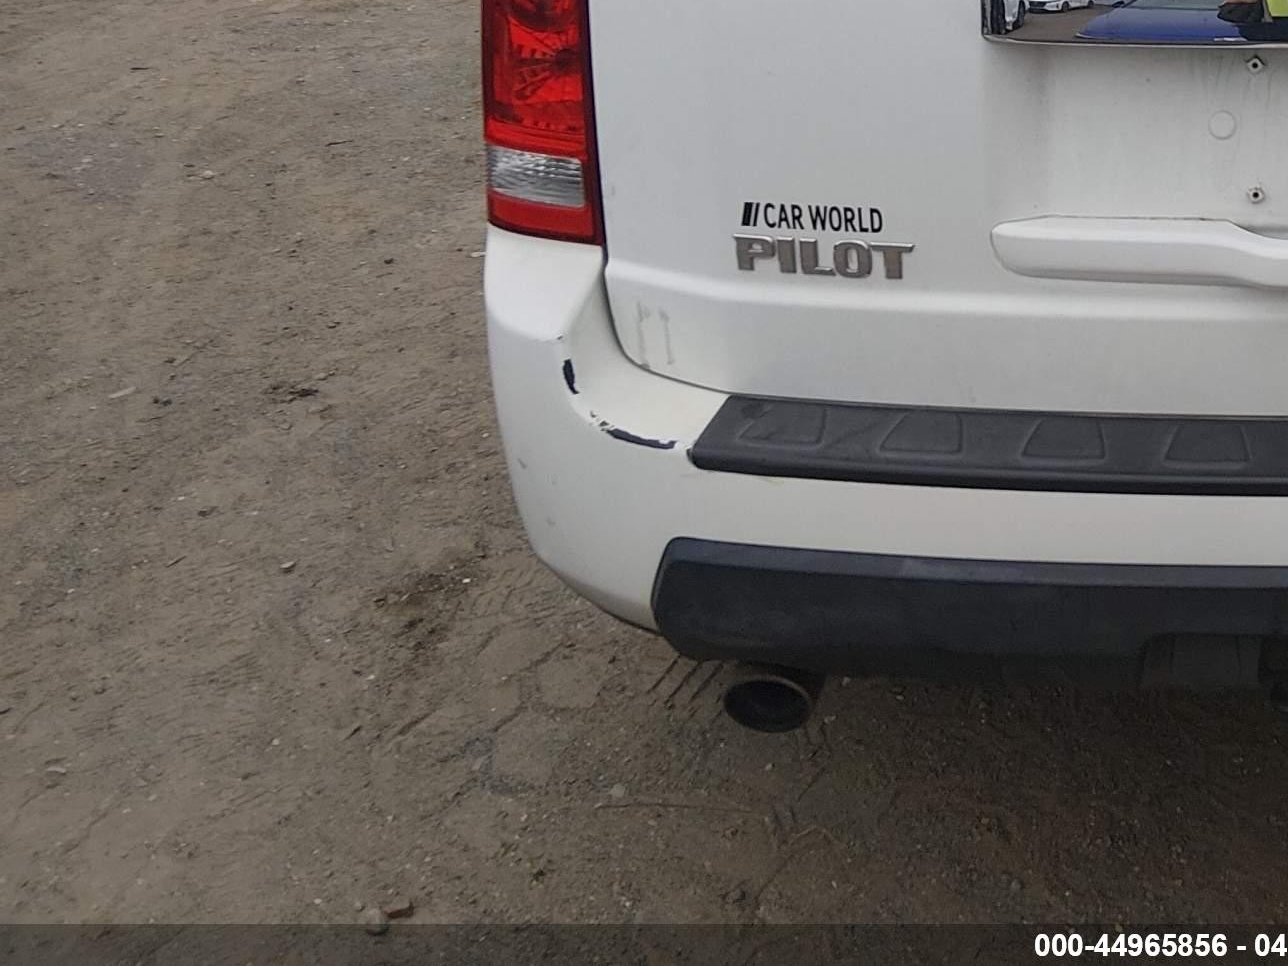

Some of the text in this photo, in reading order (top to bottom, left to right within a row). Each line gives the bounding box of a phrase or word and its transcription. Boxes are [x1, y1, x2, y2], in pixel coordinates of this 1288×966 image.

[763, 202, 883, 233] CAR WORLD
[732, 233, 915, 280] PILOT
